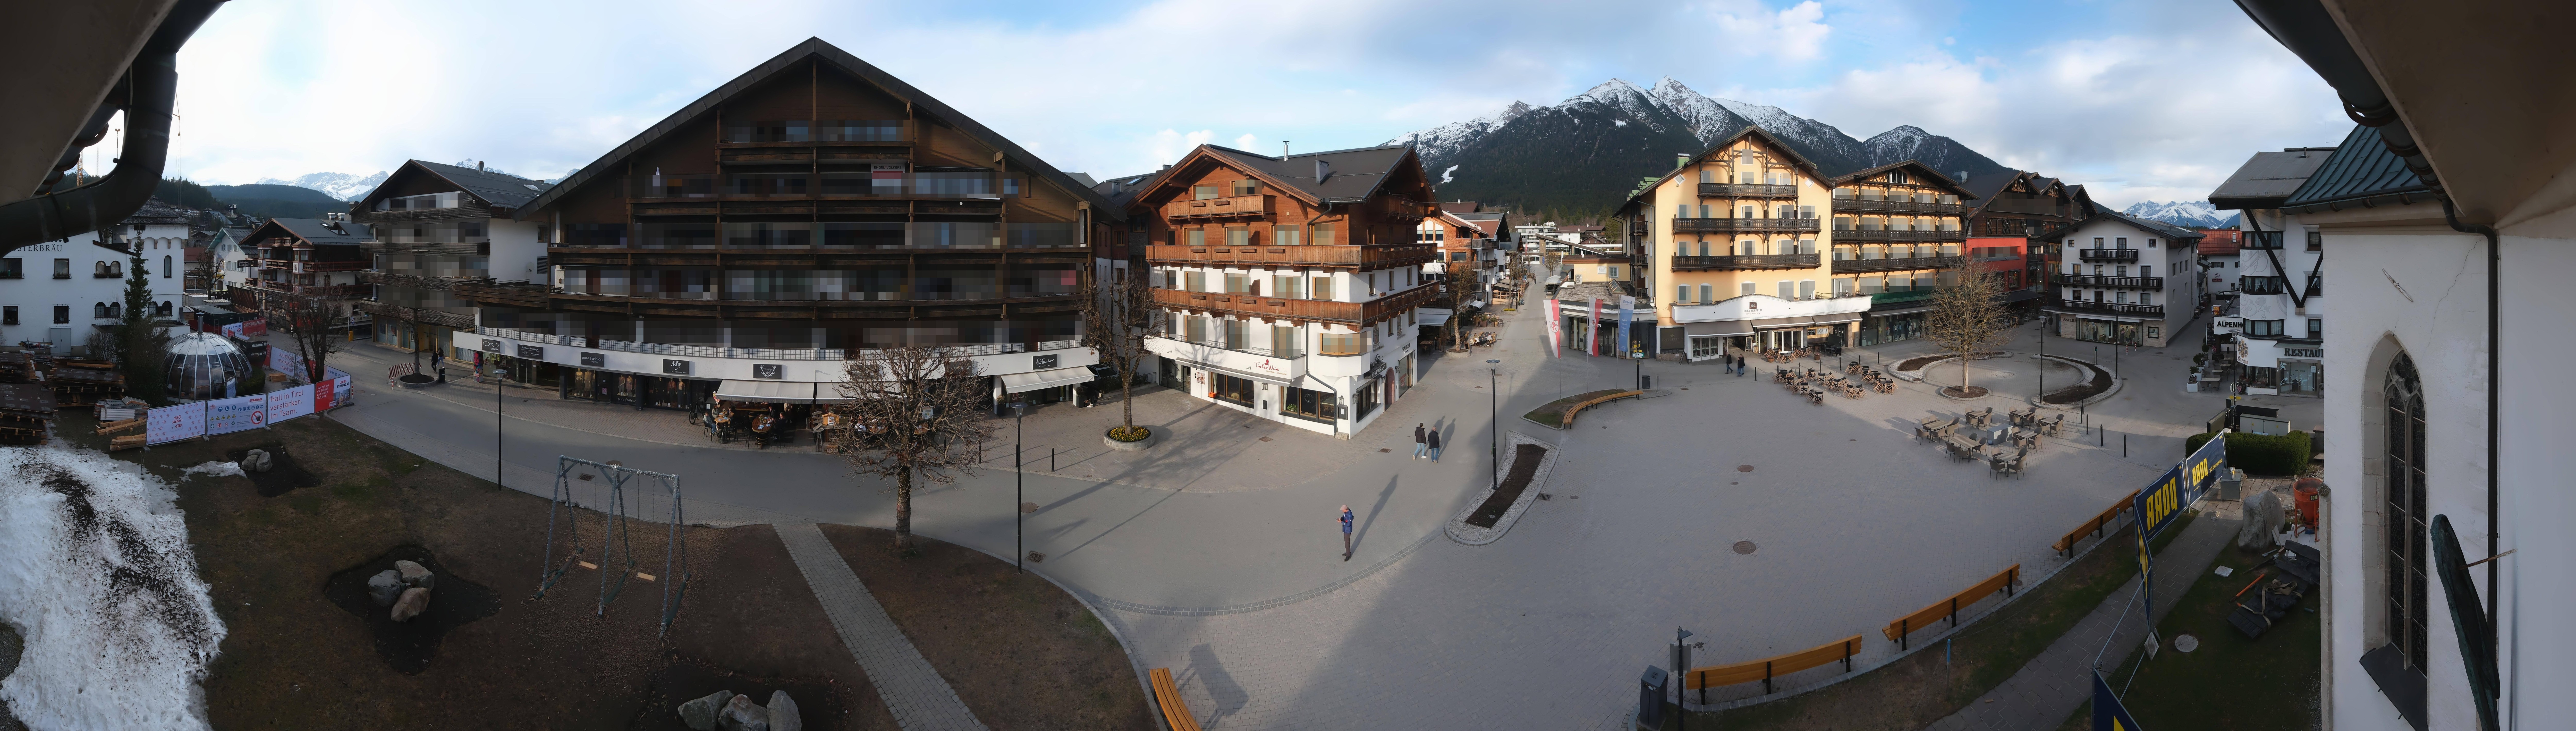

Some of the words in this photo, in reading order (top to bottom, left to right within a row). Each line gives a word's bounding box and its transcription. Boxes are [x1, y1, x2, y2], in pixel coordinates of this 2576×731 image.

[1402, 343, 1411, 351] SAILER
[1372, 364, 1386, 377] RESTAURANT
[271, 394, 282, 403] Hall
[291, 389, 303, 398] Tirol
[270, 400, 302, 411] verstärken.
